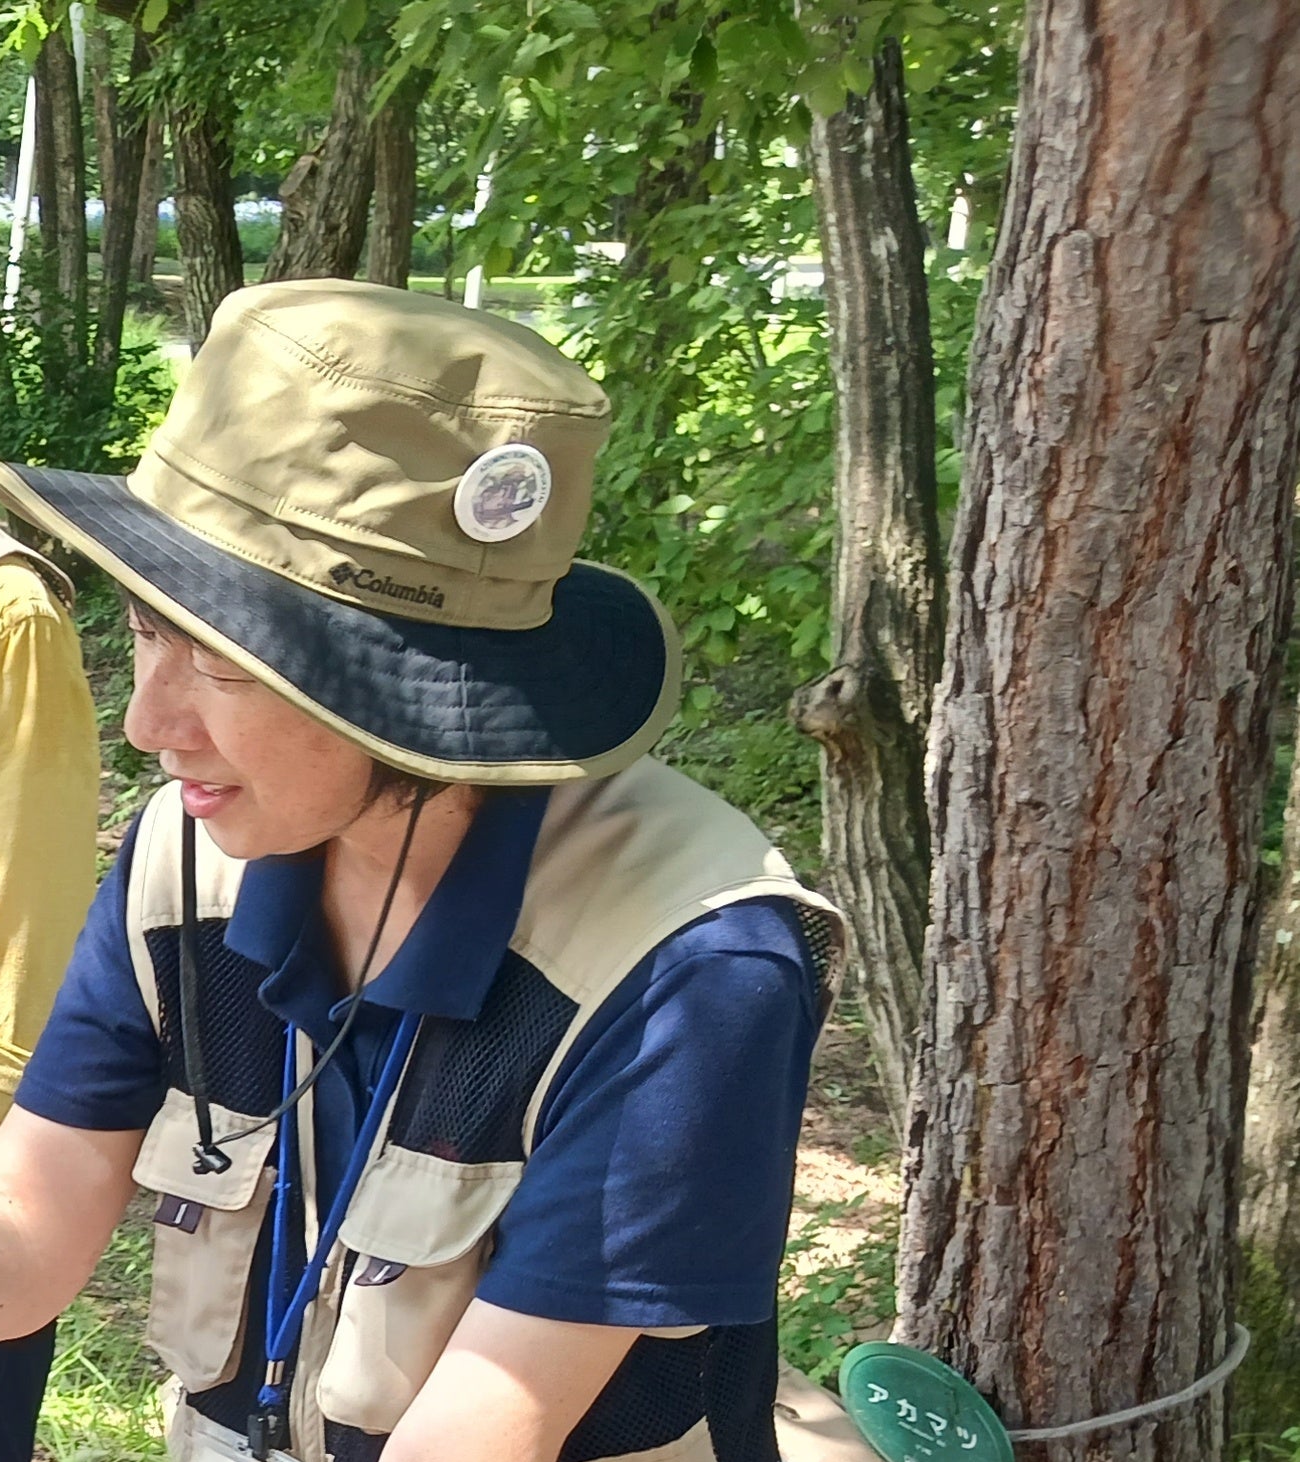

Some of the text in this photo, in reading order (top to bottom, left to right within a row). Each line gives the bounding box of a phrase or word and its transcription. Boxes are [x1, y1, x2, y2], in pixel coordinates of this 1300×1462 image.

[354, 570, 445, 609] Columbia
[866, 1383, 978, 1450] アカマツ
